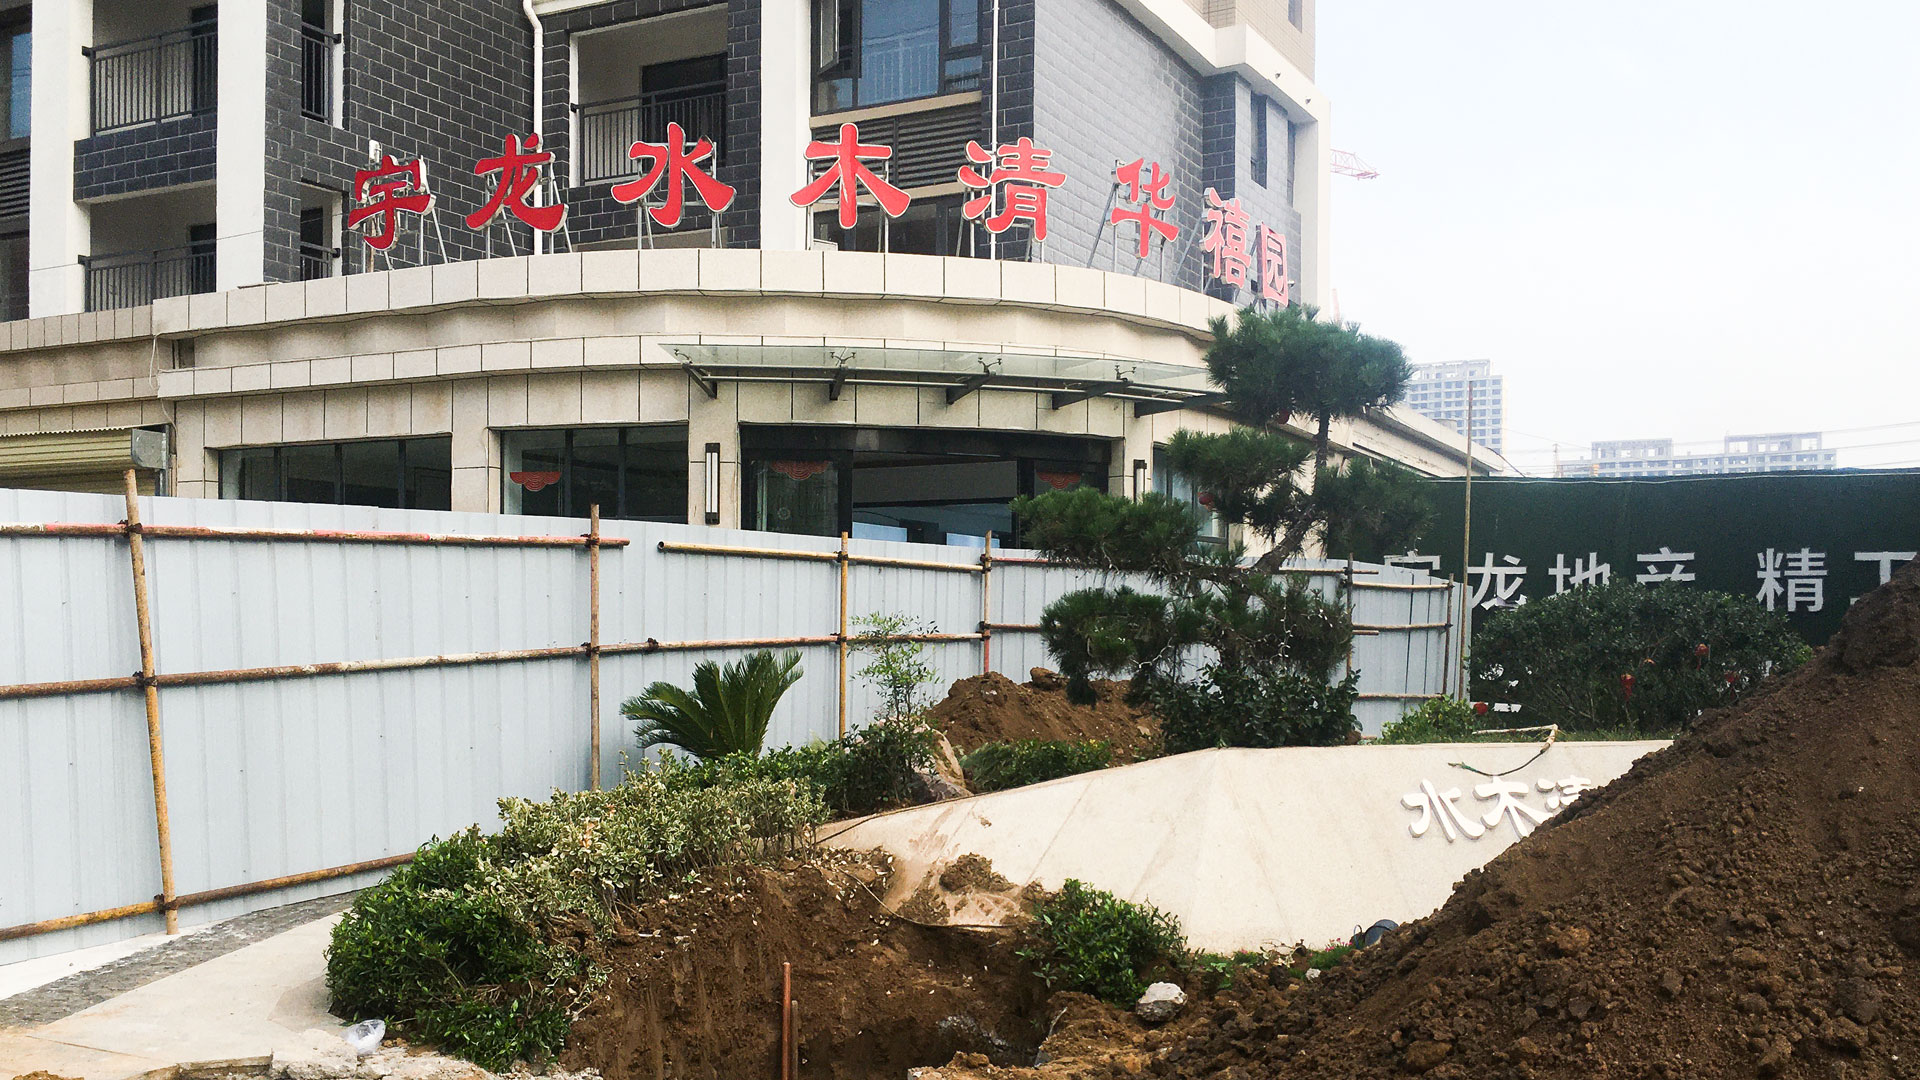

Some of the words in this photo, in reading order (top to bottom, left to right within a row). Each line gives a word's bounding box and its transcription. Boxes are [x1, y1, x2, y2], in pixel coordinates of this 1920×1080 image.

[348, 121, 1290, 307] 宇龙水木清华禧园
